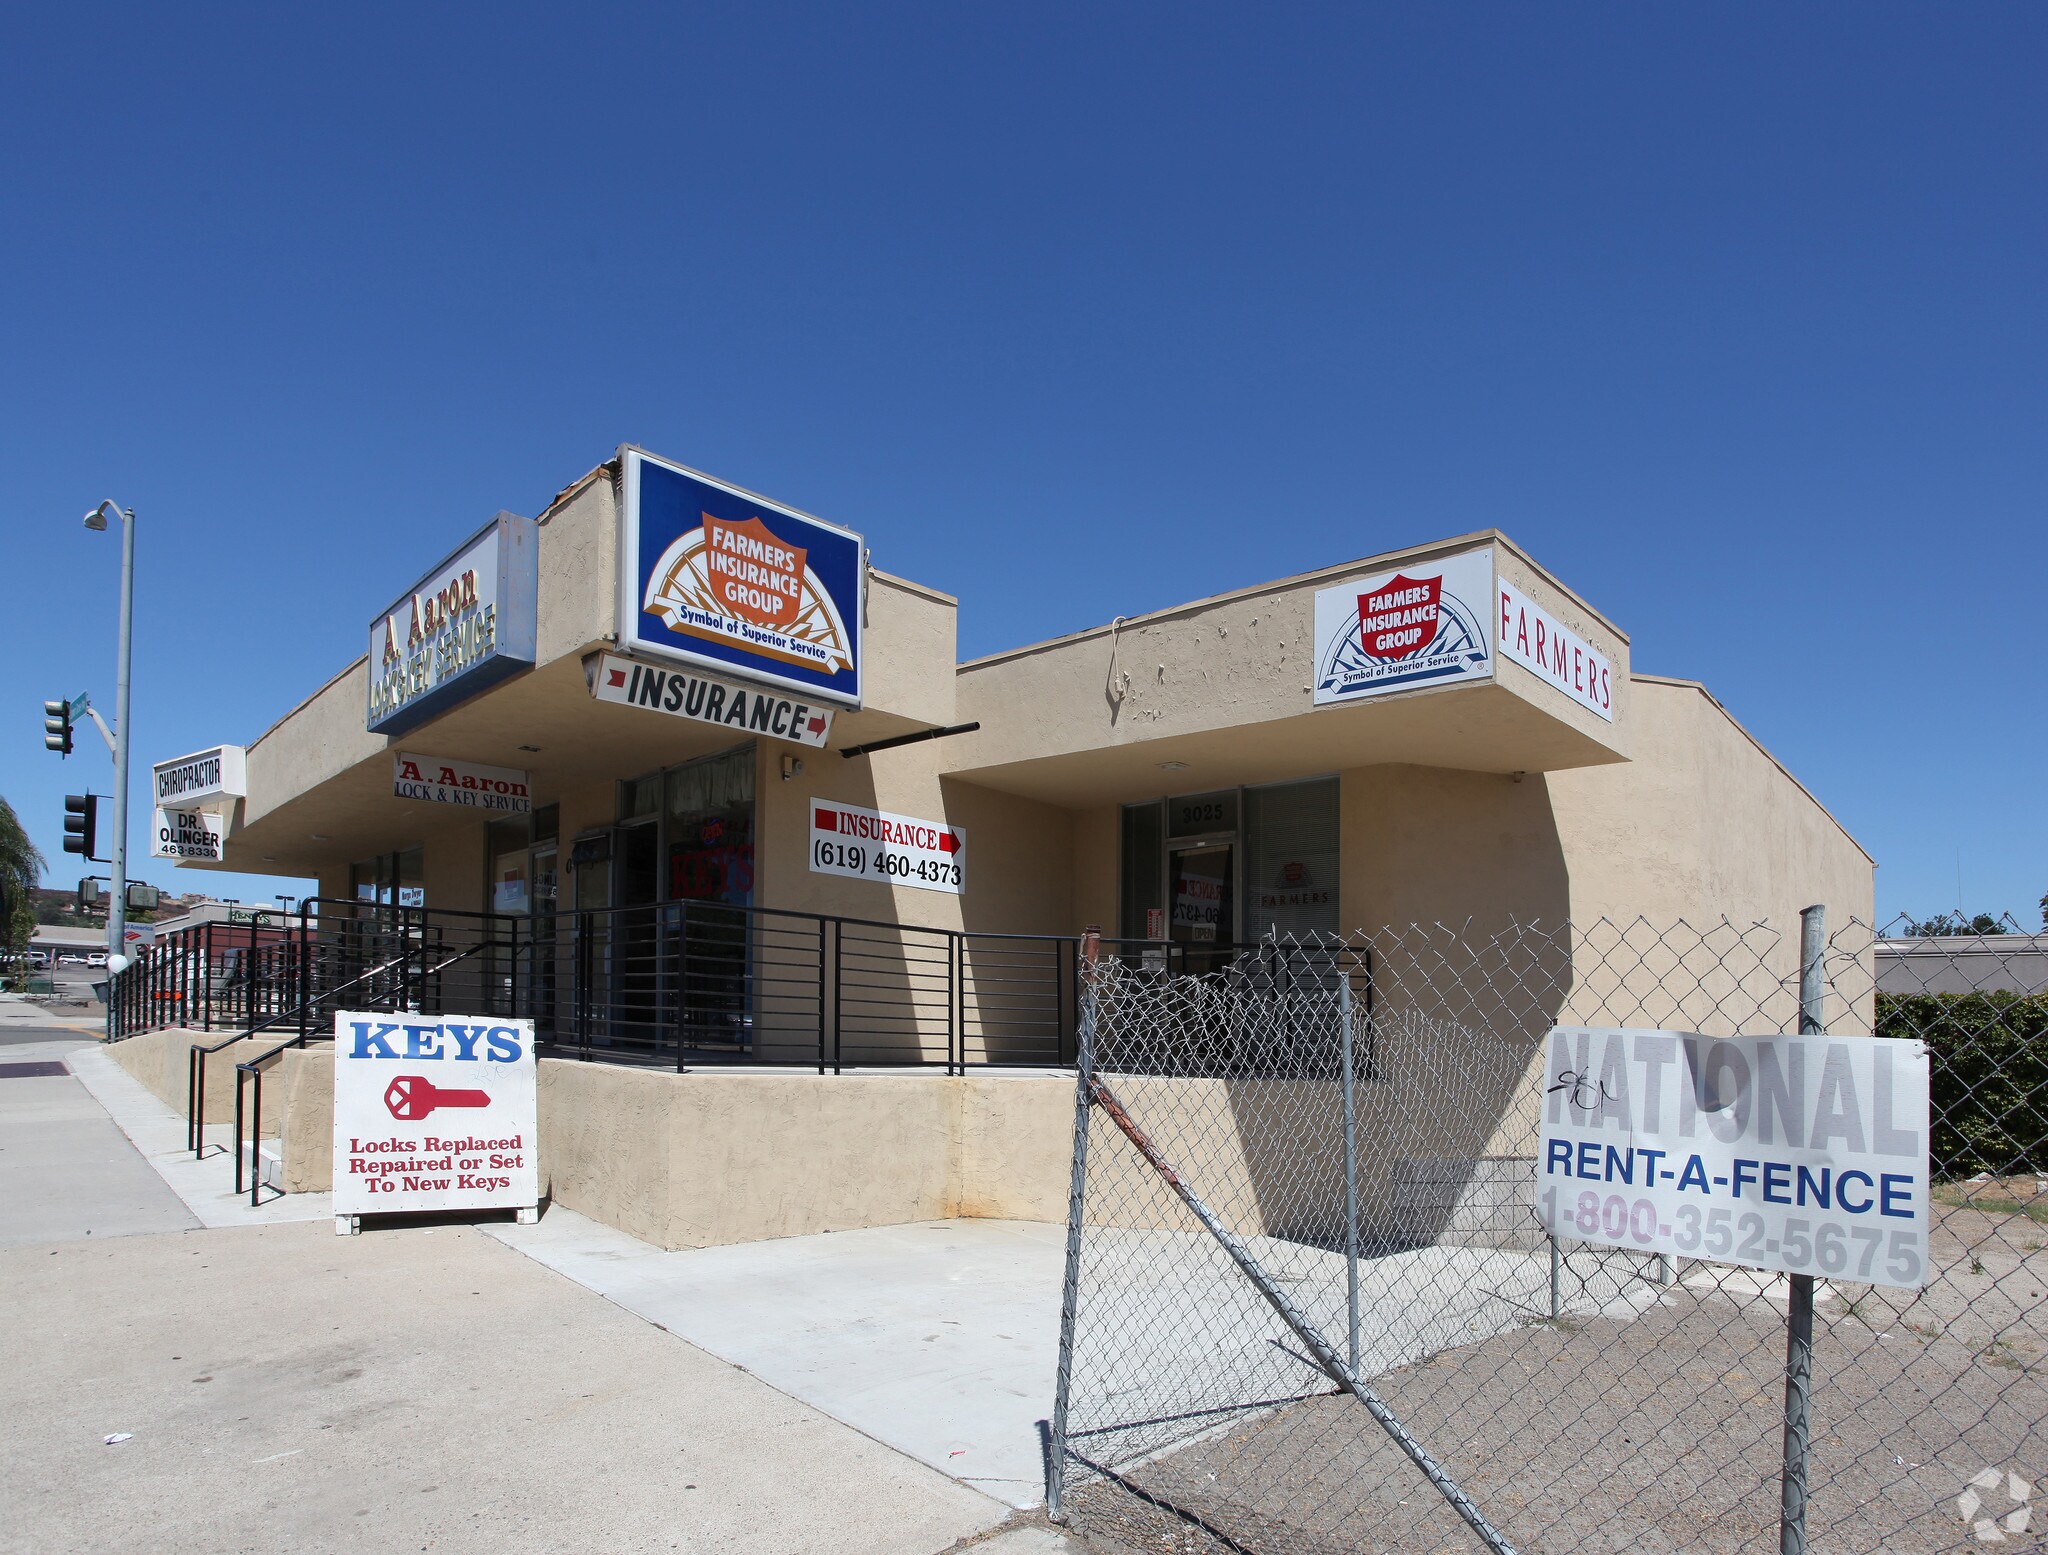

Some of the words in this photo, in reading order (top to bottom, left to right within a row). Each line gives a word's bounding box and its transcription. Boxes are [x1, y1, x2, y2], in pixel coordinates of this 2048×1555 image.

[712, 526, 795, 572] FARMERS
[711, 551, 798, 598] INSURANCE
[408, 569, 479, 647] Aaron
[725, 582, 783, 615] GROUP
[1369, 585, 1430, 613] FARMERS
[680, 605, 723, 630] Symbol
[727, 620, 739, 634] of
[742, 624, 786, 648] Superior
[790, 639, 826, 659] Service
[1362, 604, 1437, 634] INSURANCE
[406, 646, 432, 697] KEY
[435, 602, 495, 678] SERVICE
[1376, 628, 1422, 651] GROUP
[1501, 591, 1609, 709] FARMERS
[1343, 667, 1373, 683] Symbol
[1376, 665, 1385, 676] of
[1388, 661, 1424, 675] Superior
[1427, 655, 1459, 666] Service
[628, 665, 808, 740] INSURANCE
[159, 758, 220, 798] CHIROPRACTOR
[437, 767, 528, 797] Aaron
[395, 782, 431, 800] LOCK
[437, 788, 447, 801] &
[453, 790, 478, 806] KEY
[483, 794, 530, 813] SERVICE
[1183, 804, 1223, 823] 3025
[160, 828, 219, 847] OLINGER
[178, 814, 201, 829] DR.
[839, 812, 937, 850] INSURANCE
[671, 845, 754, 899] KEYS
[814, 839, 866, 874] (619)
[873, 852, 962, 885] 460-4373
[1261, 892, 1328, 906] FARMERS
[1194, 927, 1213, 939] OPEN
[349, 1022, 522, 1063] KEYS
[1547, 1033, 1919, 1157] NATIONAL
[350, 1138, 417, 1154] Locks
[424, 1135, 523, 1156] Replaced
[349, 1156, 453, 1177] Repaired
[459, 1159, 483, 1170] or
[490, 1154, 524, 1169] Set
[1546, 1138, 1915, 1218] RENT-A-FENCE
[365, 1178, 395, 1193] To
[402, 1176, 451, 1192] New
[457, 1174, 511, 1192] Keys
[1541, 1185, 1921, 1283] 1-800-352-5675
